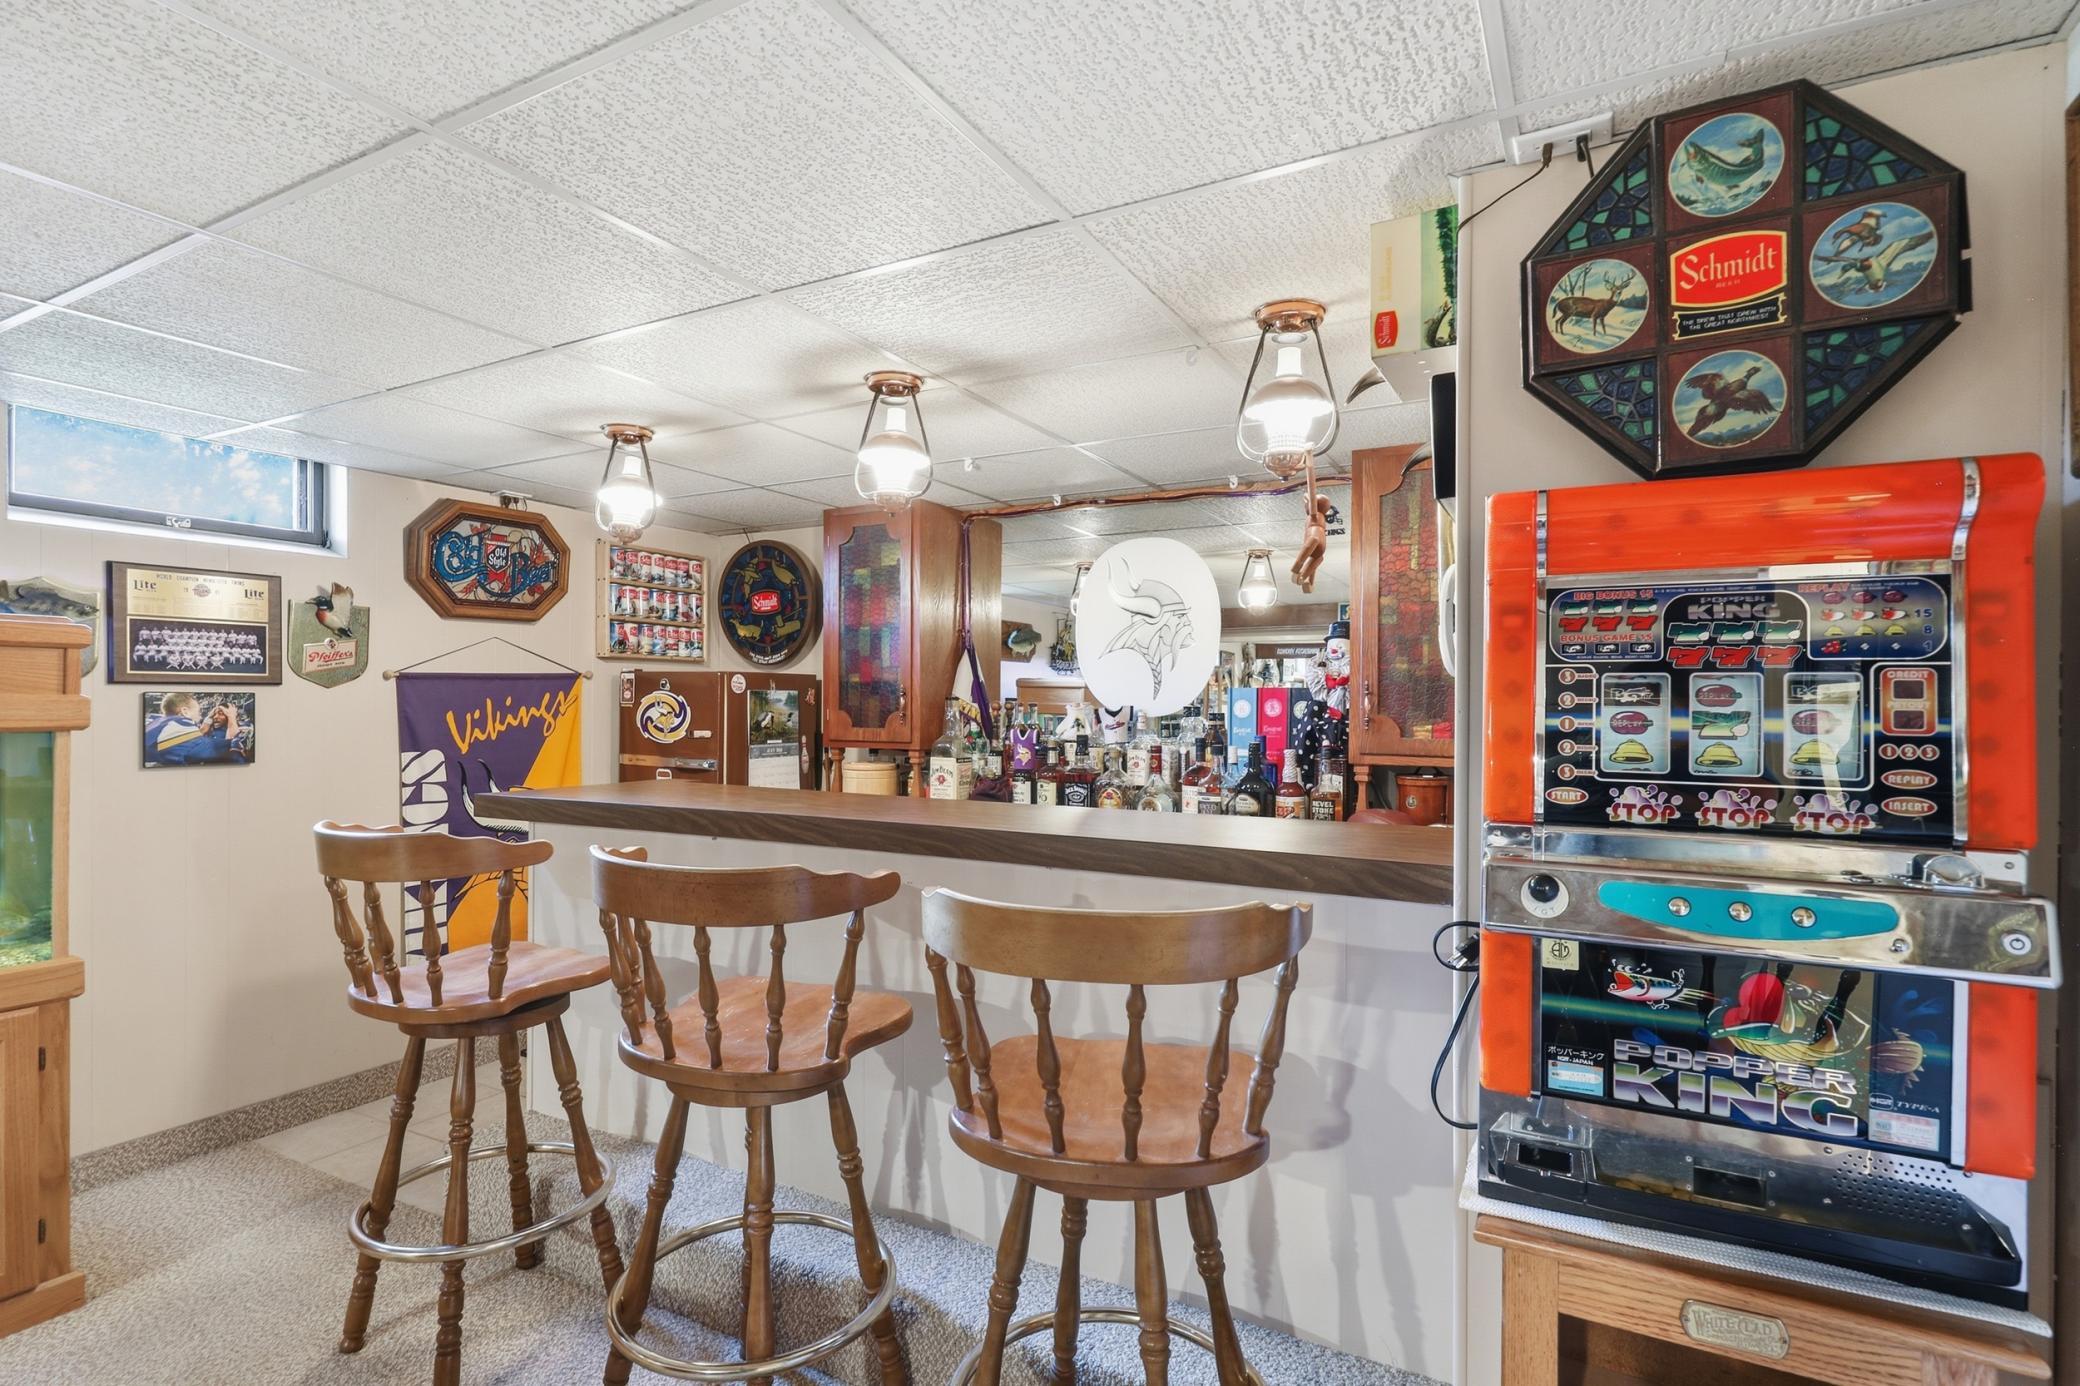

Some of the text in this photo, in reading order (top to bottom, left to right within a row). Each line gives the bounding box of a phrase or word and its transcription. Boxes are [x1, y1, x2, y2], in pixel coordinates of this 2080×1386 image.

[1680, 242, 1778, 290] Schmidt
[494, 545, 508, 557] Old
[488, 554, 507, 568] Style
[133, 579, 157, 592] Lite
[1797, 582, 1850, 593] REPLAY
[244, 589, 264, 599] Lite
[1596, 590, 1637, 599] BONUS
[1700, 596, 1766, 604] POPPER
[1687, 602, 1781, 620] KING
[1915, 608, 1933, 618] 15
[1923, 624, 1934, 635] 8
[1560, 634, 1600, 642] BONUS
[1886, 670, 1930, 679] CREDIT
[1563, 695, 1572, 706] 2
[446, 690, 577, 755] Vikings
[1562, 742, 1572, 753] 2
[1904, 747, 1914, 757] 2
[1888, 774, 1931, 784] REPLAY
[1550, 790, 1582, 800] START
[1610, 802, 1678, 822] STOP
[1888, 801, 1931, 812] INSERT
[1699, 807, 1771, 827] STOP
[1794, 812, 1873, 833] STOP
[1613, 1038, 1857, 1094] POPPER
[1613, 1062, 1858, 1137] KING
